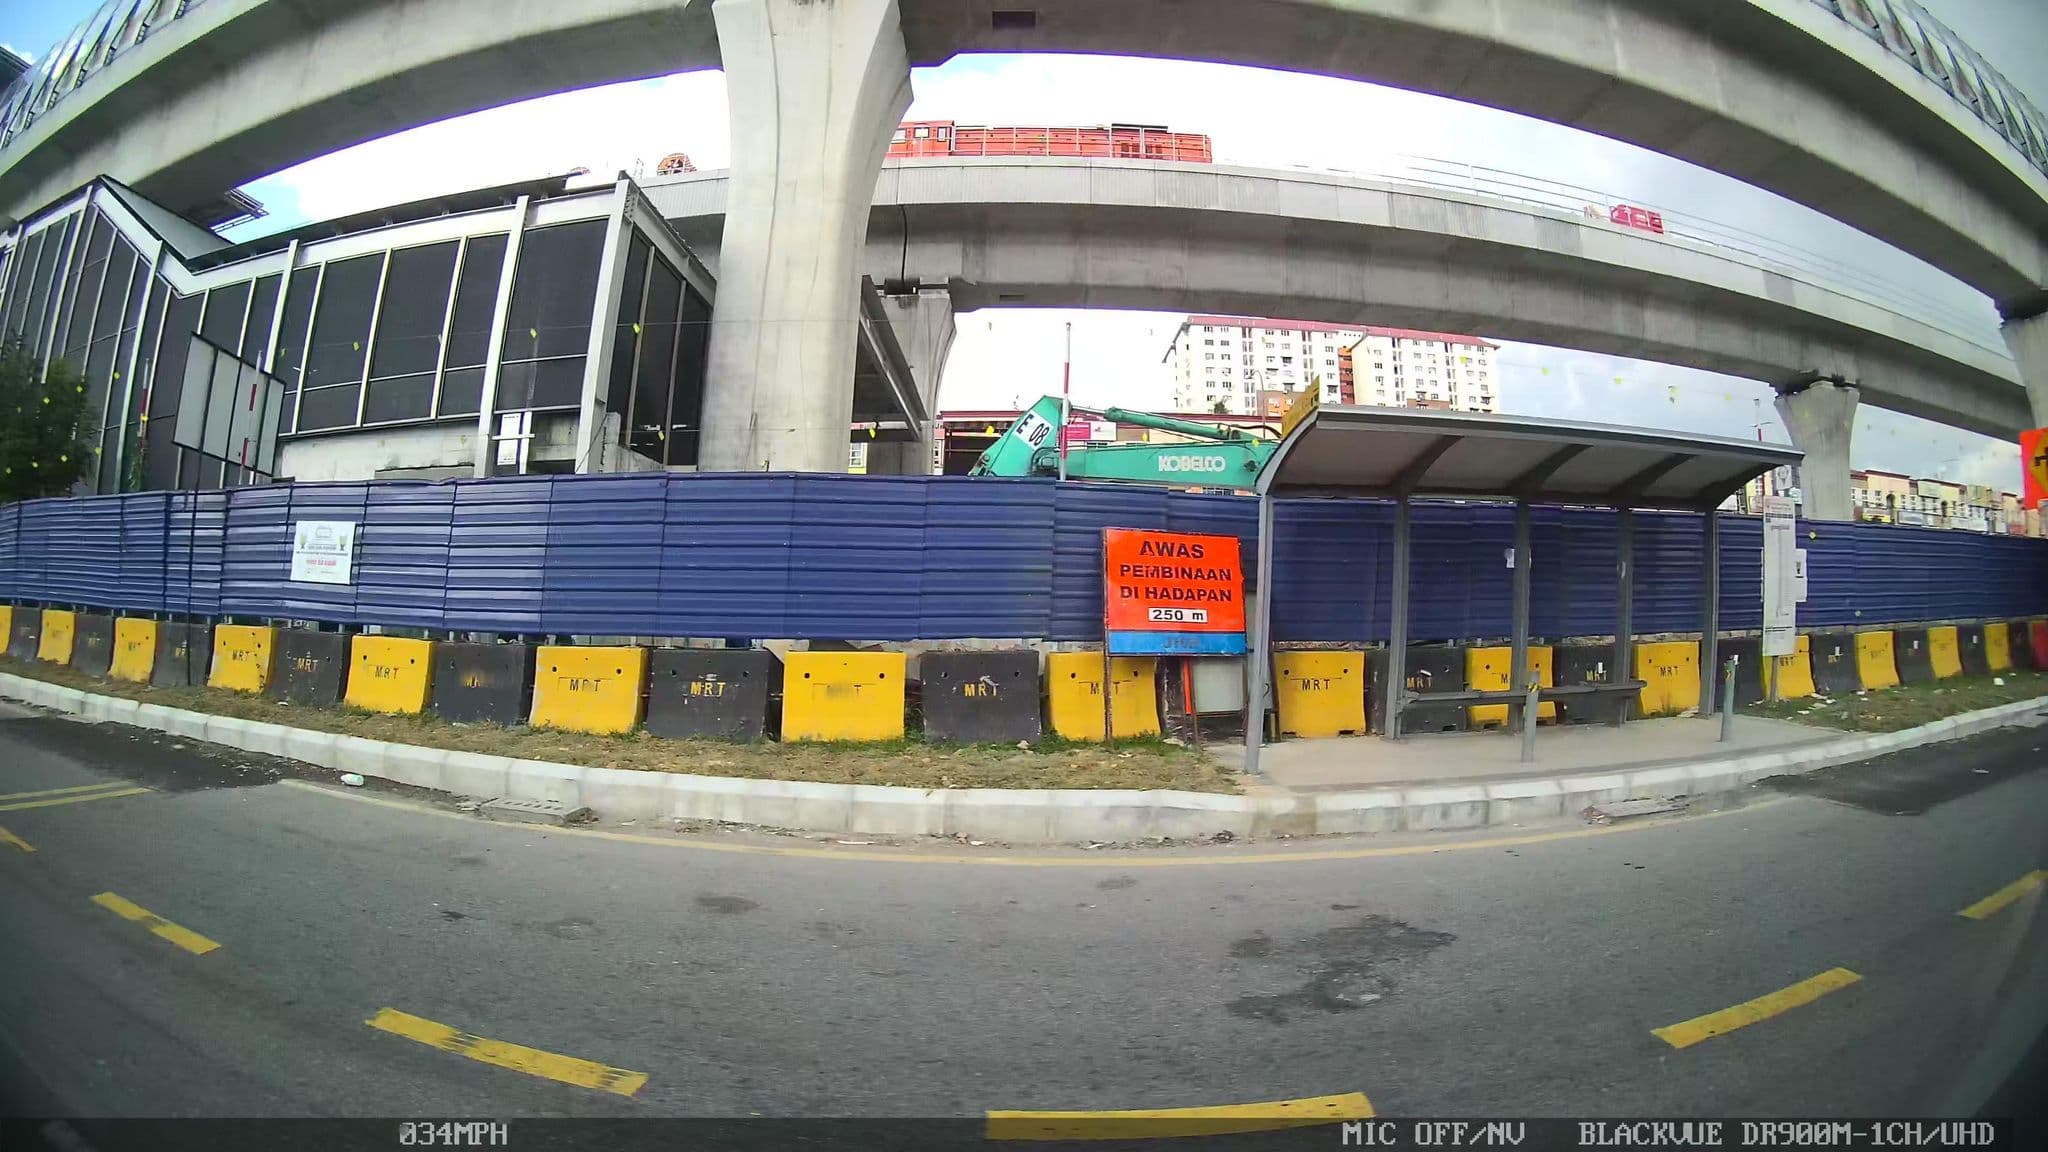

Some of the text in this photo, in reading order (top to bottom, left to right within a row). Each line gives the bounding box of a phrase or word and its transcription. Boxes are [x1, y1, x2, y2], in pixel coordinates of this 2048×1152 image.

[1158, 455, 1226, 472] KOBELCO
[1139, 541, 1204, 558] AWAS
[1120, 564, 1231, 581] PEMBINAAN
[1120, 585, 1232, 602] DI HADAPAN
[1152, 609, 1204, 621] 250 m
[297, 658, 319, 672] MRT
[1660, 666, 1679, 678] MRT
[375, 666, 399, 680] MRT
[691, 681, 727, 698] MRT
[964, 683, 999, 697] MRT
[1090, 681, 1121, 695] MT
[1302, 678, 1330, 691] MRT
[1406, 677, 1432, 689] MRT
